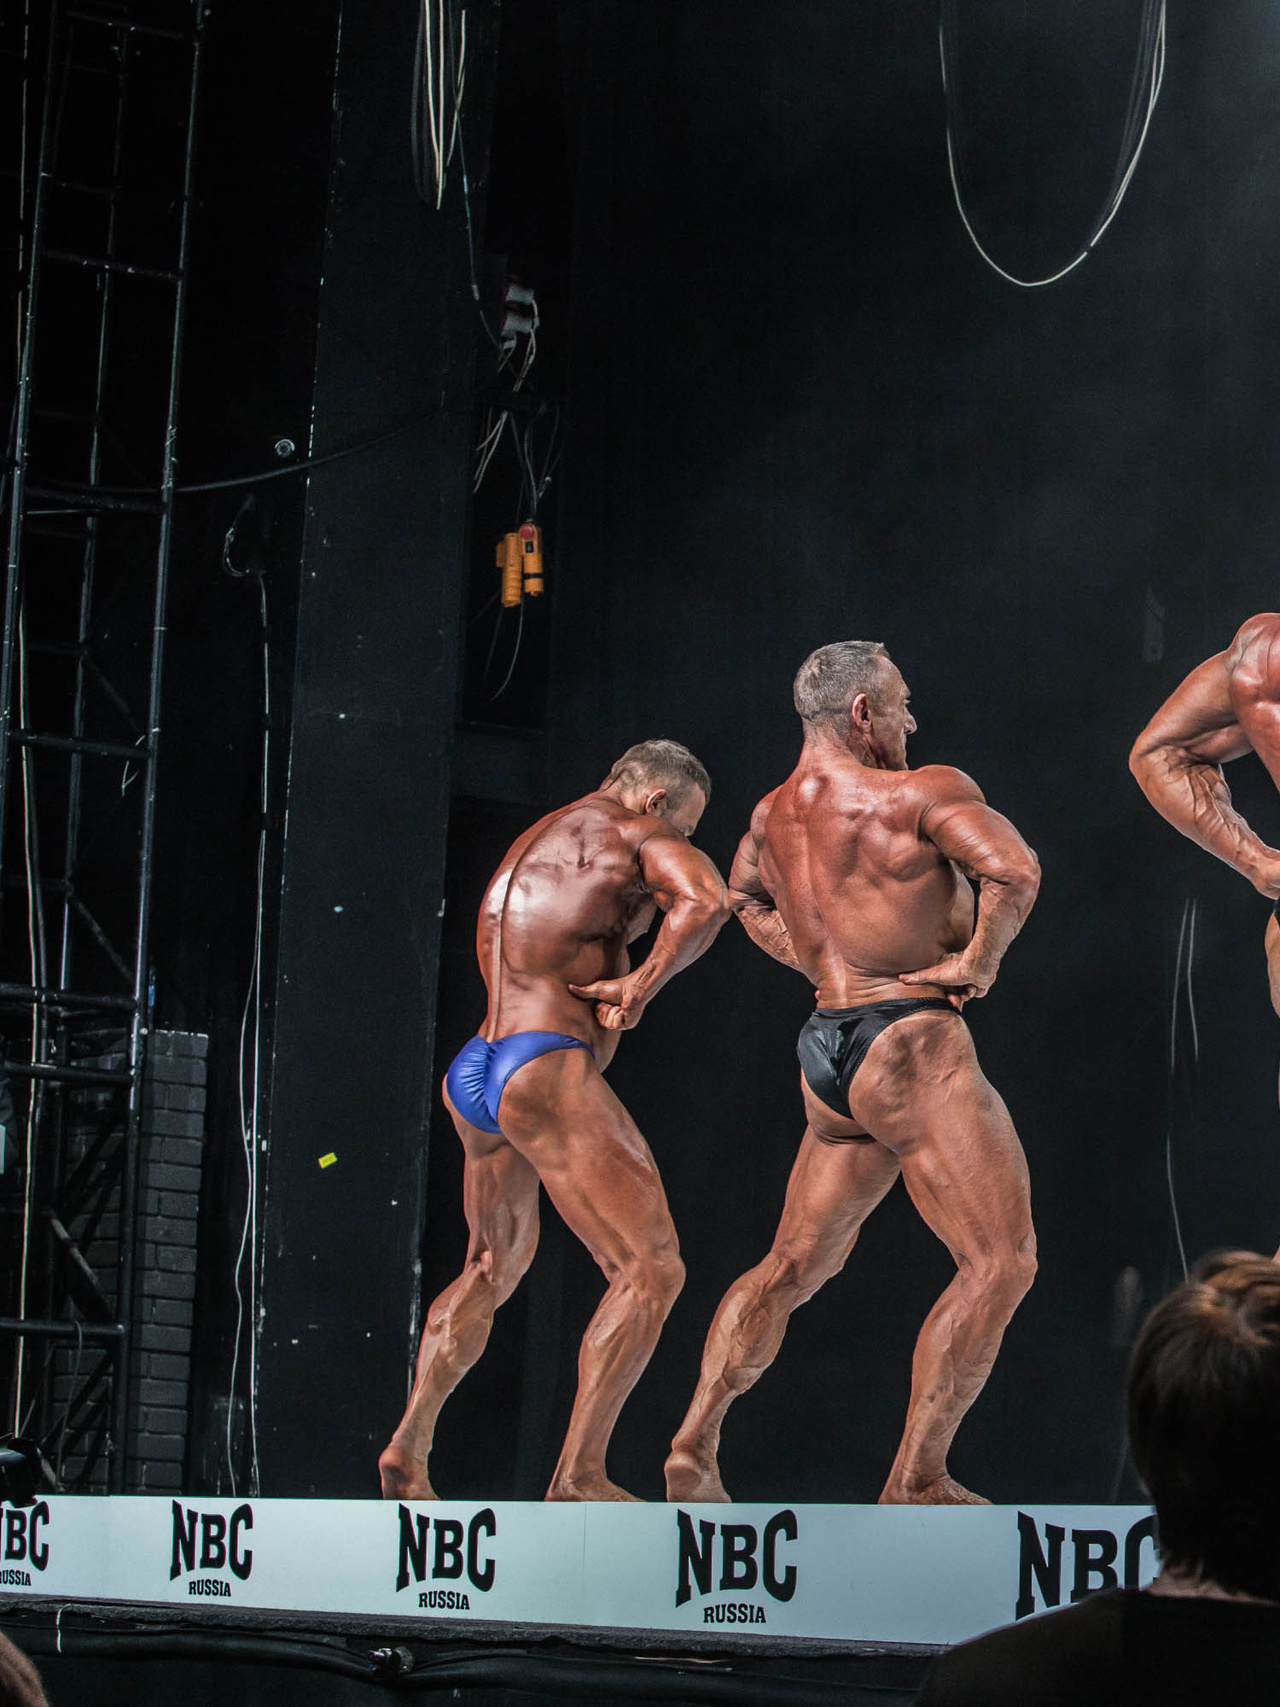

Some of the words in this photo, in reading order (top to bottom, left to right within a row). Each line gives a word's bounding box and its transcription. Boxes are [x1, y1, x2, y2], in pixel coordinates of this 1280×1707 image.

[0, 1501, 49, 1571] BC
[170, 1499, 253, 1581] NBC
[396, 1503, 496, 1592] NBC
[675, 1509, 797, 1608] NBC
[188, 1578, 231, 1597] RUSSIA
[418, 1590, 470, 1610] RUSSIA
[703, 1603, 766, 1624] RUSSIA
